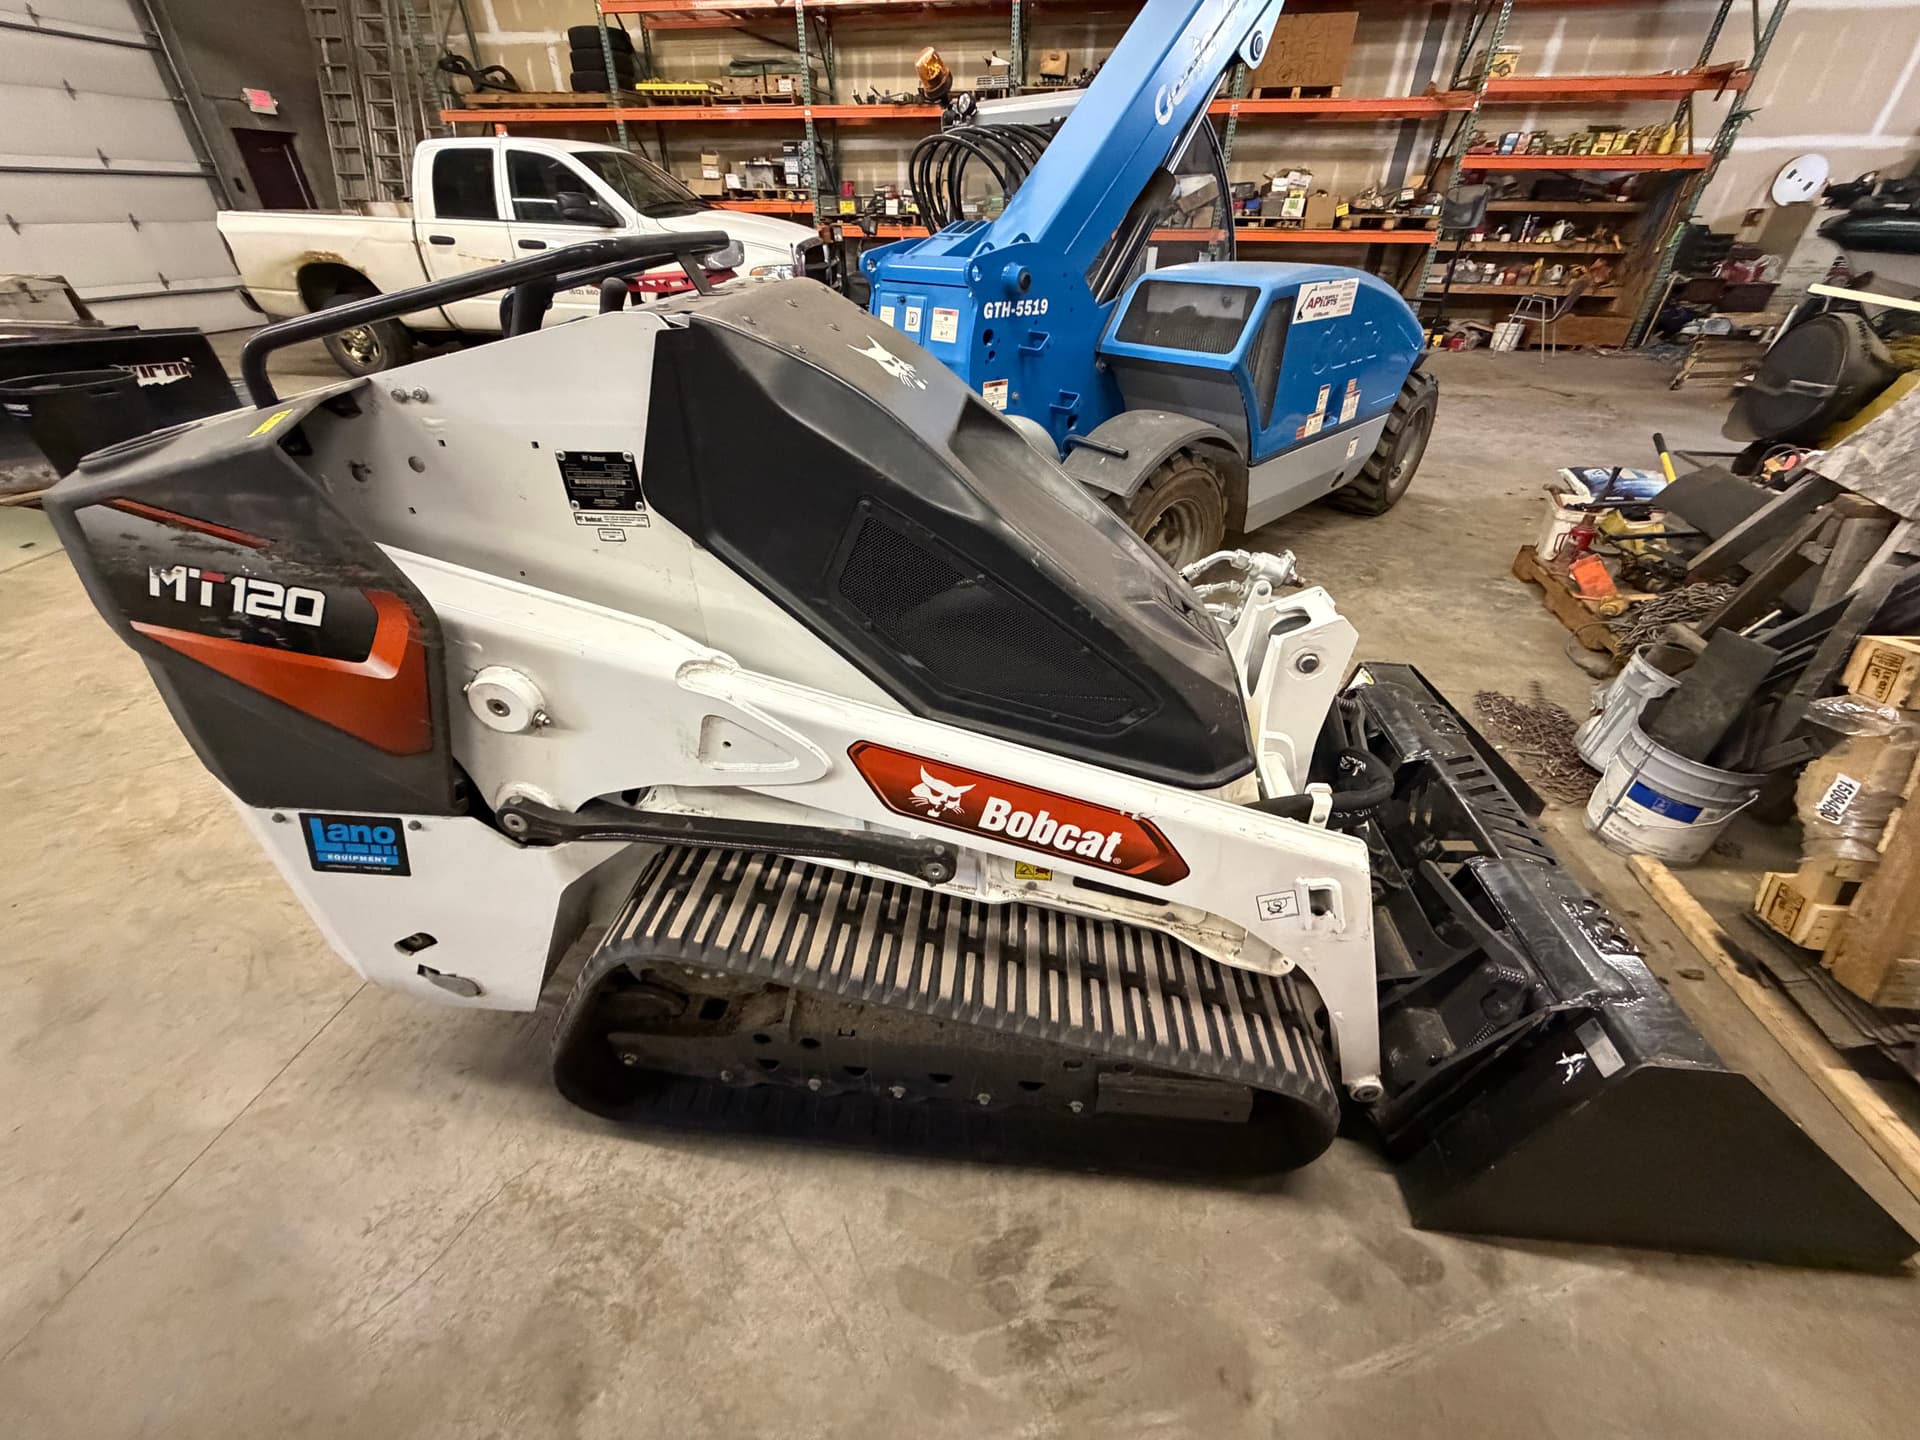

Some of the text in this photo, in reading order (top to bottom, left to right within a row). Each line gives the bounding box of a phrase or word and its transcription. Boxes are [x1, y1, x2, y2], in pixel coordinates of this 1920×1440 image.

[983, 298, 1049, 319] GTH-5519
[149, 565, 326, 627] MT120
[309, 817, 396, 852] Lano
[978, 796, 1122, 863] Bobcat
[327, 853, 389, 864] EQUIPMENT
